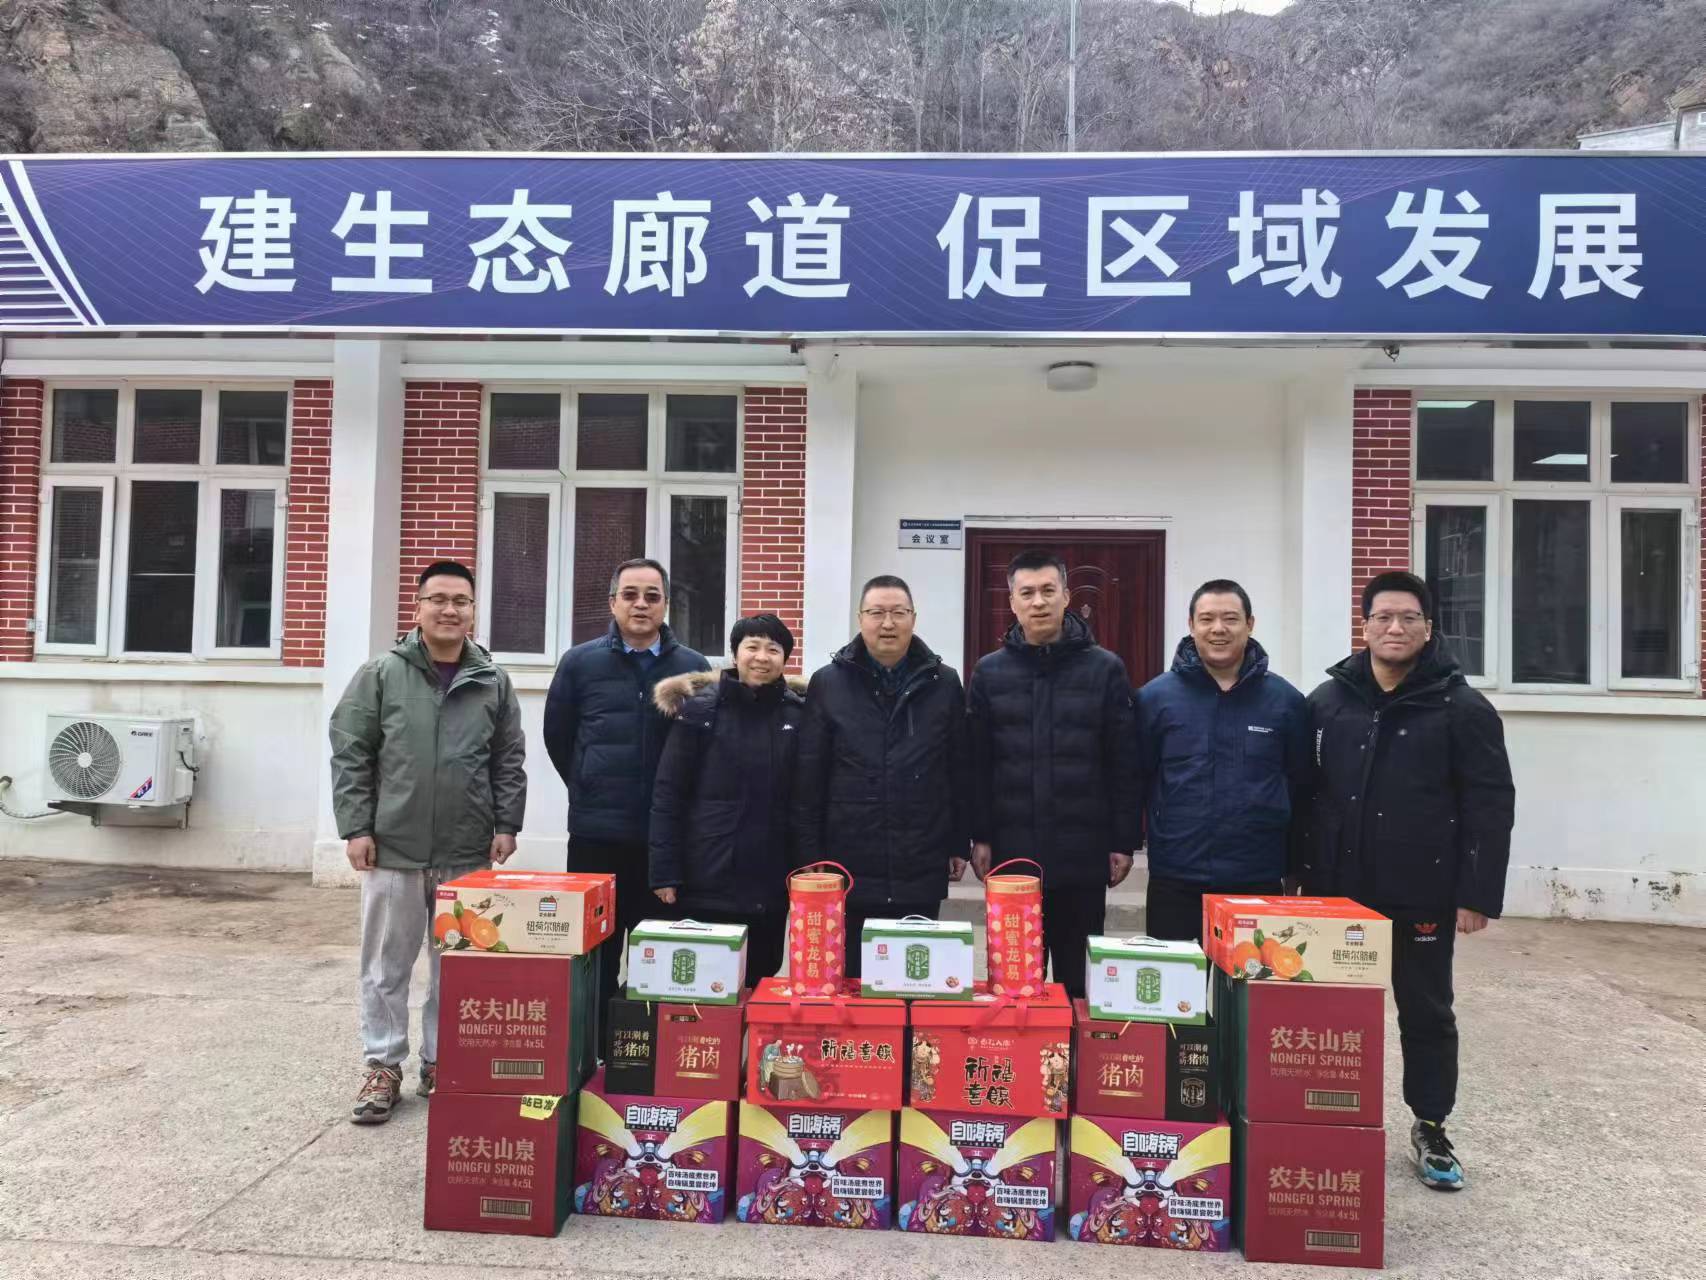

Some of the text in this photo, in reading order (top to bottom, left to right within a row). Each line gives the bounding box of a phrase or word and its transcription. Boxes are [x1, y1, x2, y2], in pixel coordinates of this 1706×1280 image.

[194, 187, 1645, 301] 建生态廊道 促区域发展
[911, 534, 950, 545] 会议室
[458, 997, 547, 1022] 农夫山泉
[458, 1023, 547, 1036] NONGFU SPRING
[1270, 1026, 1363, 1053] 农夫山泉
[624, 1042, 650, 1057] 猪肉
[676, 1044, 721, 1069] 猪肉
[1270, 1052, 1362, 1067] NONGFU SPRING
[1097, 1062, 1145, 1088] 猪肉
[626, 1105, 678, 1127] 自嗨锅
[788, 1114, 842, 1135] 自嗨锅
[951, 1121, 1005, 1143] 自嗨锅
[448, 1135, 535, 1161] 农夫山泉
[1123, 1132, 1179, 1155] 自嗨锅
[447, 1160, 535, 1176] NONGFU SPRING
[1268, 1166, 1361, 1193] 农夫山泉
[1268, 1191, 1361, 1208] NONGFU SPRING
